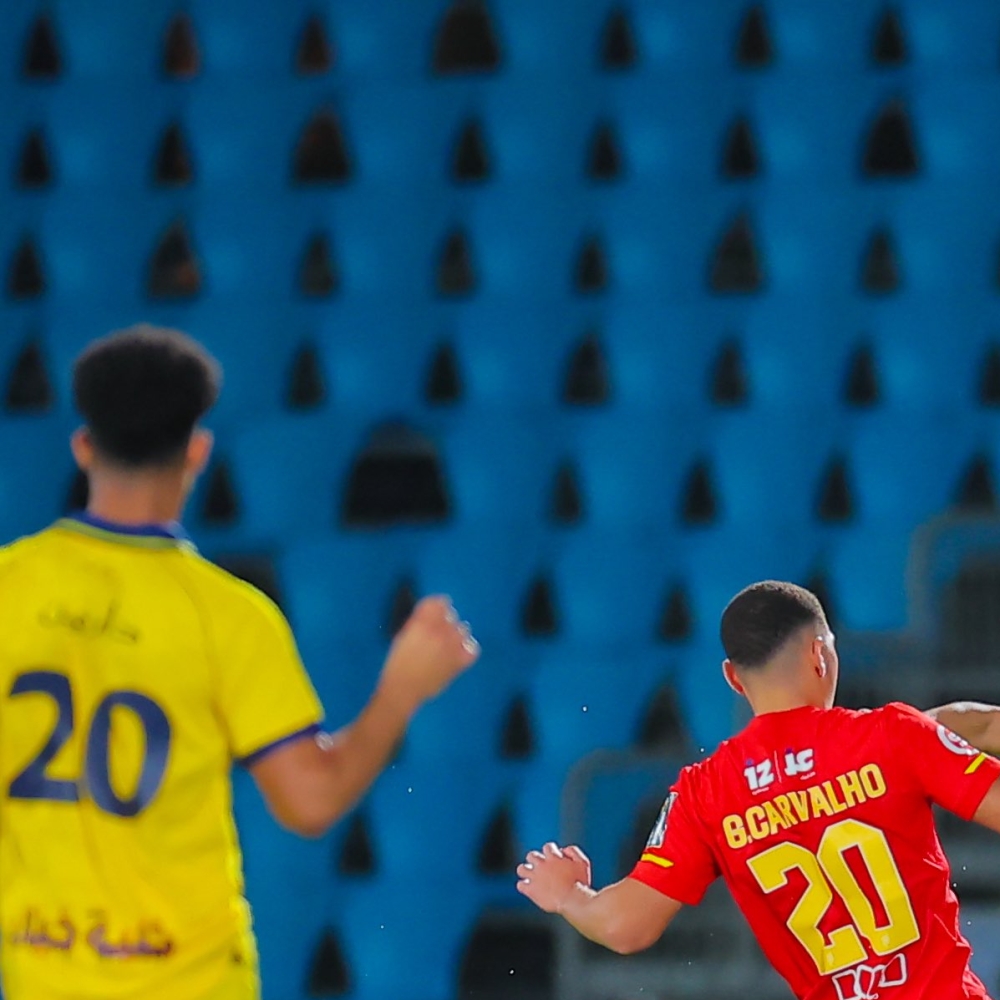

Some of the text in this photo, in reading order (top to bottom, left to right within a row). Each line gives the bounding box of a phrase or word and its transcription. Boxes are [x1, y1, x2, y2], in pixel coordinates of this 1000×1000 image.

[8, 670, 171, 817] 20
[722, 763, 887, 849] G.CARVALHO
[746, 818, 920, 976] 20
